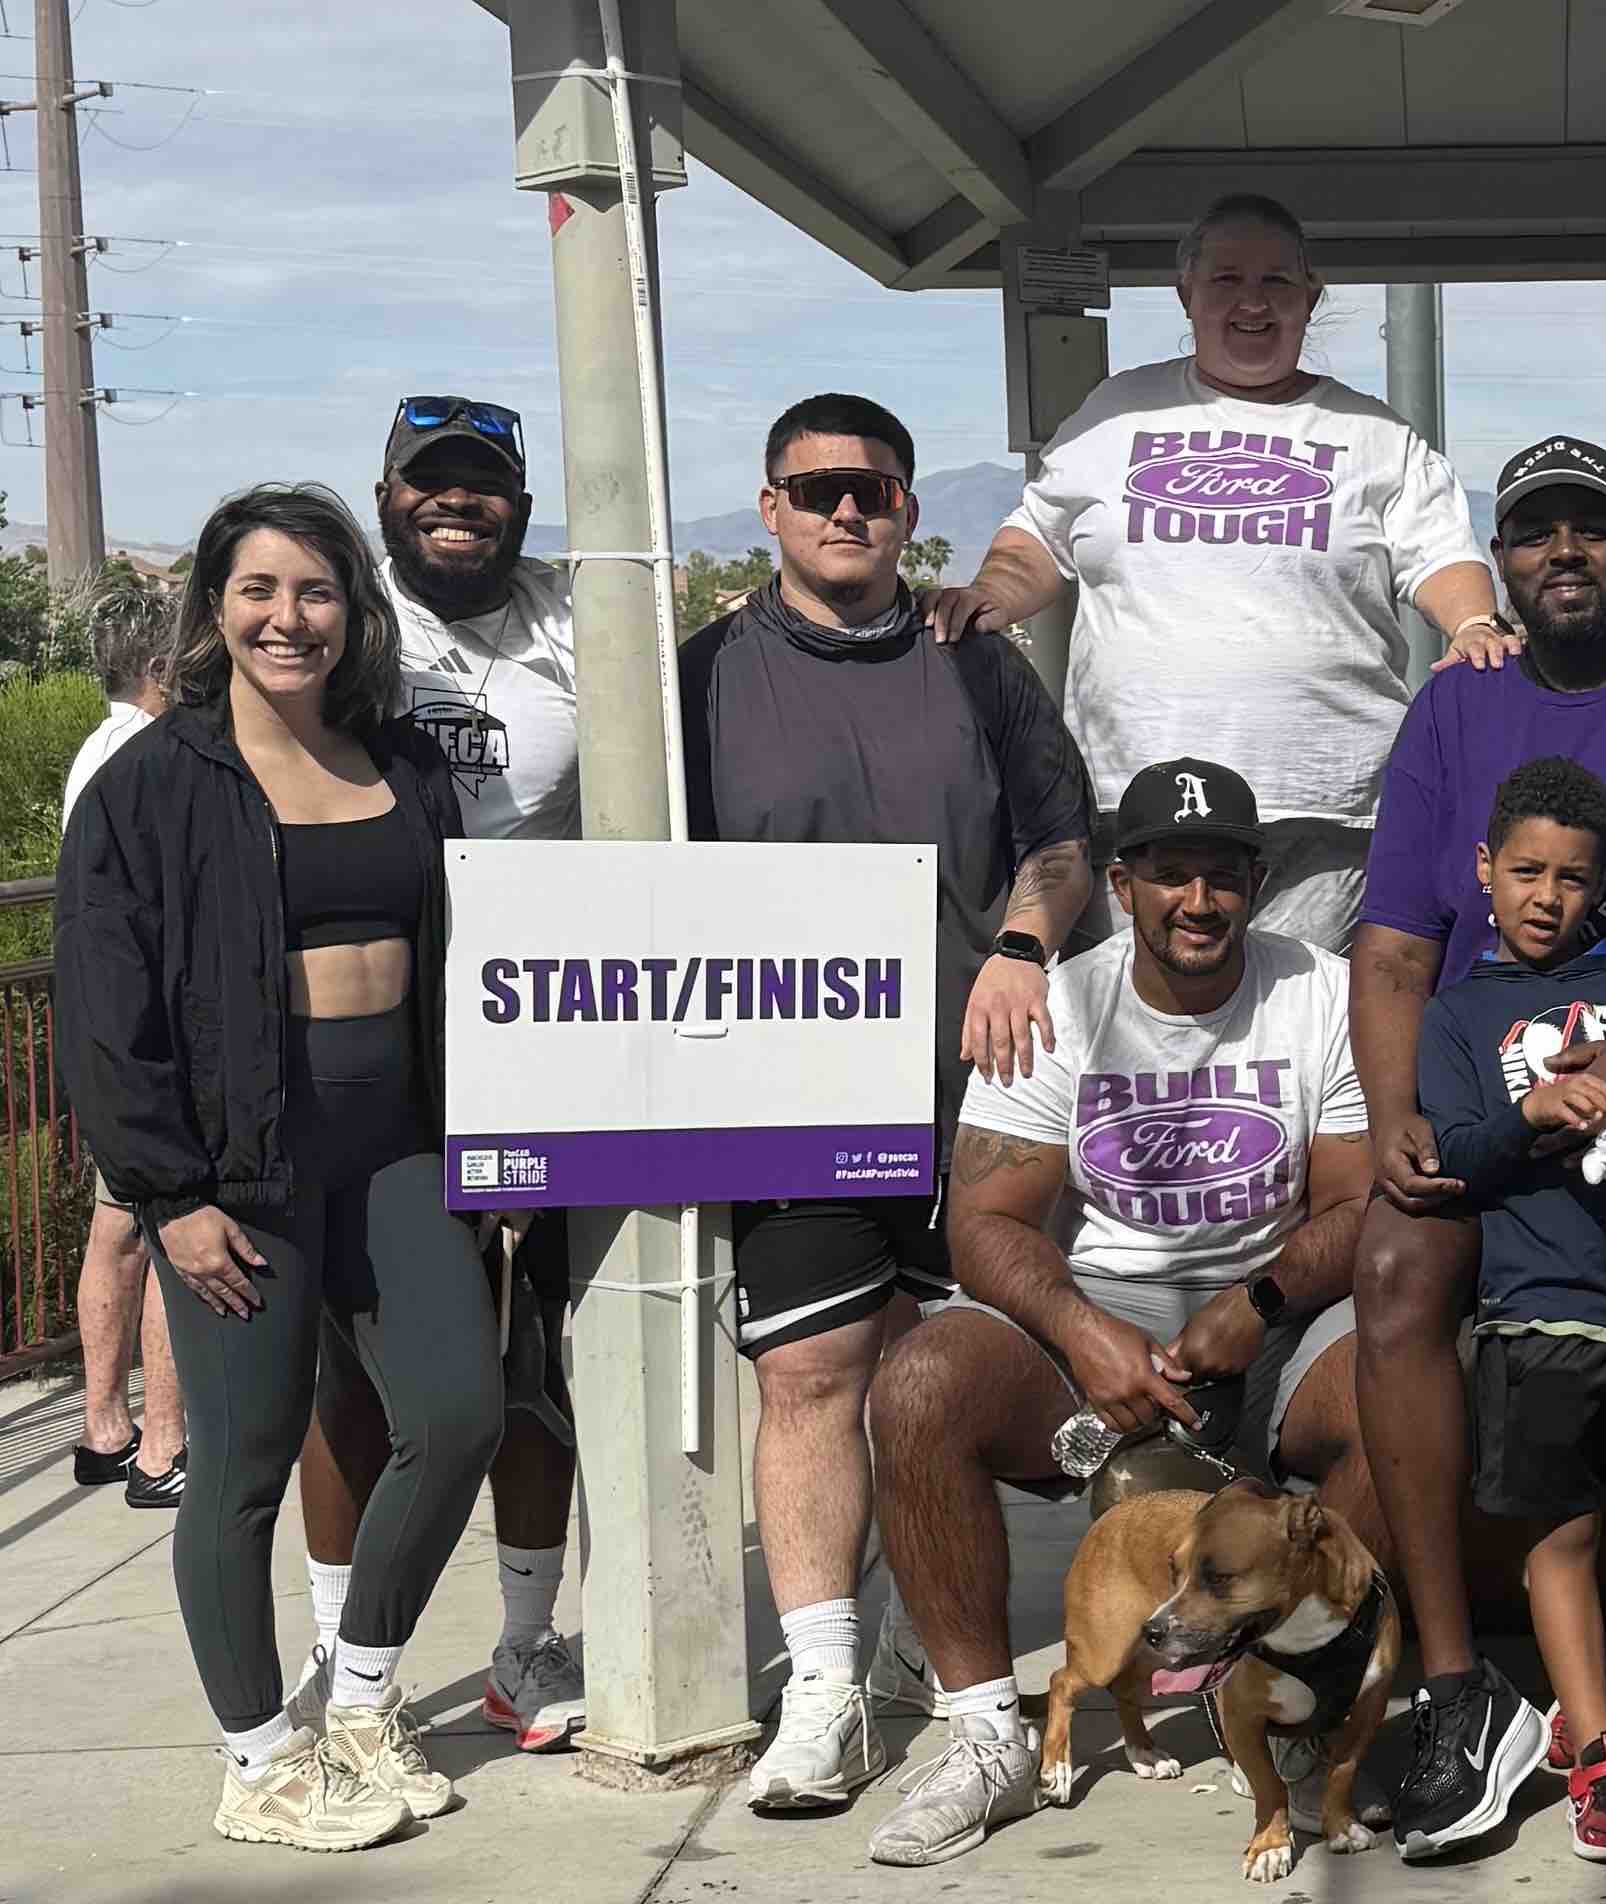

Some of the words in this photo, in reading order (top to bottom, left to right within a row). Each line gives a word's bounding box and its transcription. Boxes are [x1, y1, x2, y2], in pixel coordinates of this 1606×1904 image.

[1129, 430, 1349, 472] BUILT
[1165, 461, 1292, 496] Ford
[1122, 494, 1333, 552] TOUGH
[1174, 772, 1213, 824] A
[481, 956, 902, 1024] START/FINISH
[1076, 1058, 1292, 1128] BUILT
[503, 1157, 548, 1170] PURPLE
[1119, 1117, 1241, 1172] Ford
[503, 1170, 548, 1185] STRIDE
[1089, 1153, 1289, 1227] TOUGH
